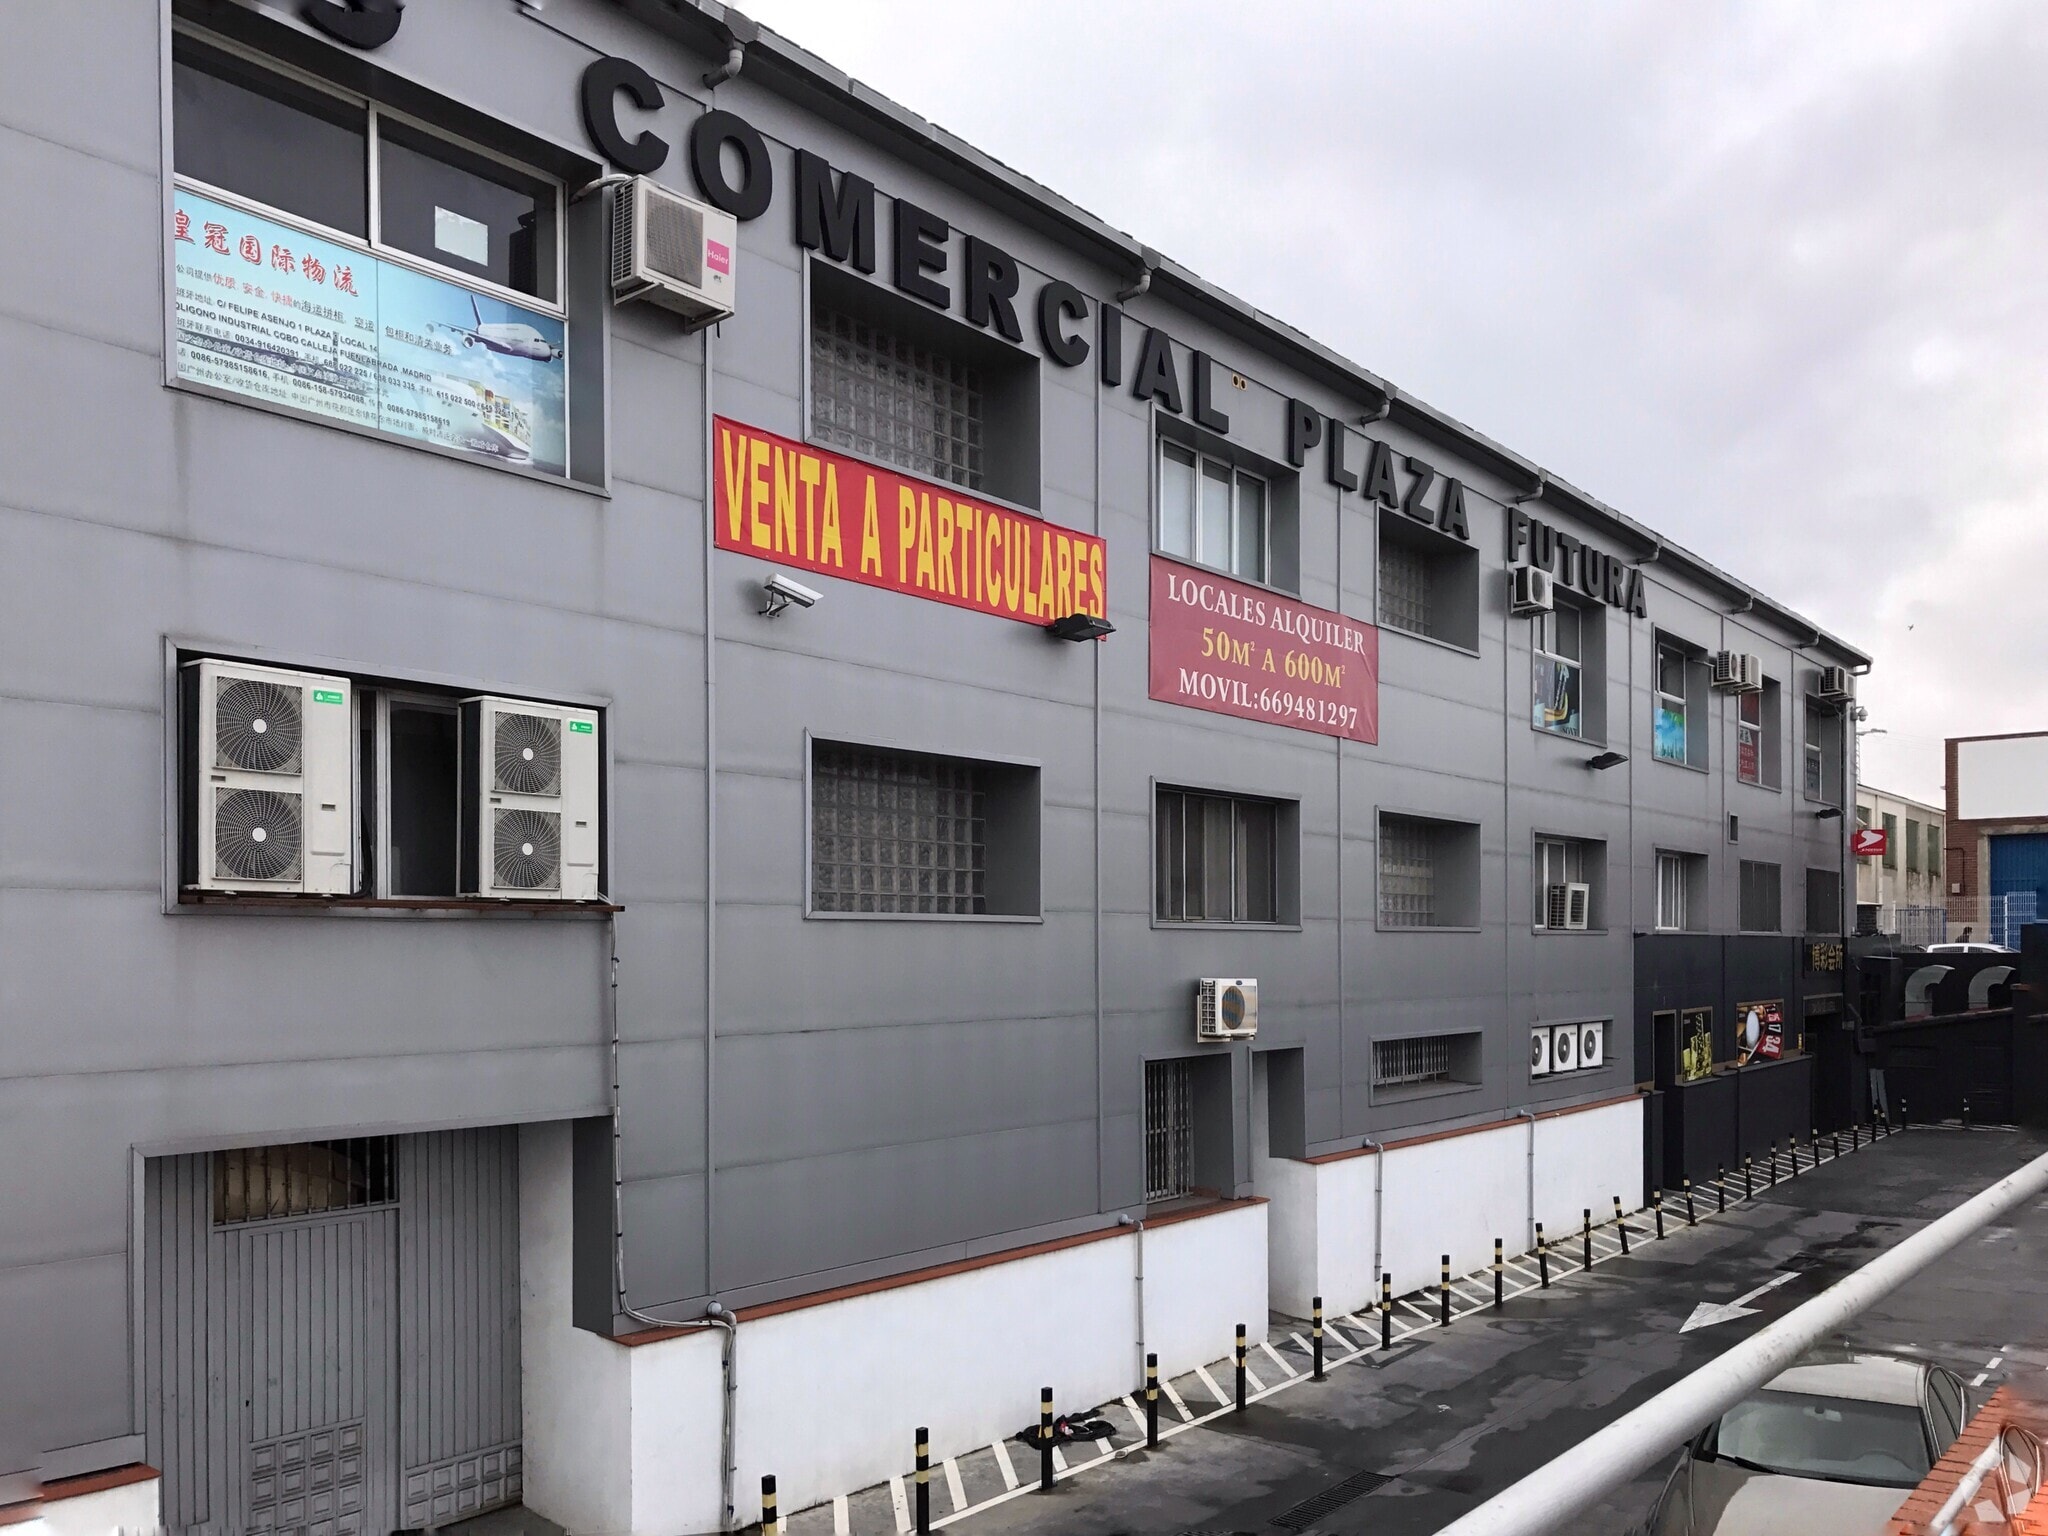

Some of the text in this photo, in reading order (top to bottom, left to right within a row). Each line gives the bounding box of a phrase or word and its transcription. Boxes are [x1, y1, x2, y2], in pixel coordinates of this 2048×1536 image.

[175, 208, 359, 297] 皇冠国际物流
[707, 249, 729, 265] Haier
[219, 314, 272, 337] INDUSTRIAL
[273, 330, 299, 345] COBO
[300, 338, 338, 355] CALLEJA
[228, 302, 260, 319] FELIPE
[261, 312, 296, 330] ASENJO
[304, 325, 332, 339] PLAZA
[340, 336, 367, 350] LOCAL
[582, 56, 1647, 618] COMERCIAL PLAZA FUTURA
[722, 429, 1103, 621] VENTA A PARTICULARES
[1167, 573, 1366, 656] LOCALES ALQUILER
[1261, 648, 1277, 673] A
[1178, 667, 1358, 730] MOVIL:669481297
[1762, 1034, 1781, 1054] 34
